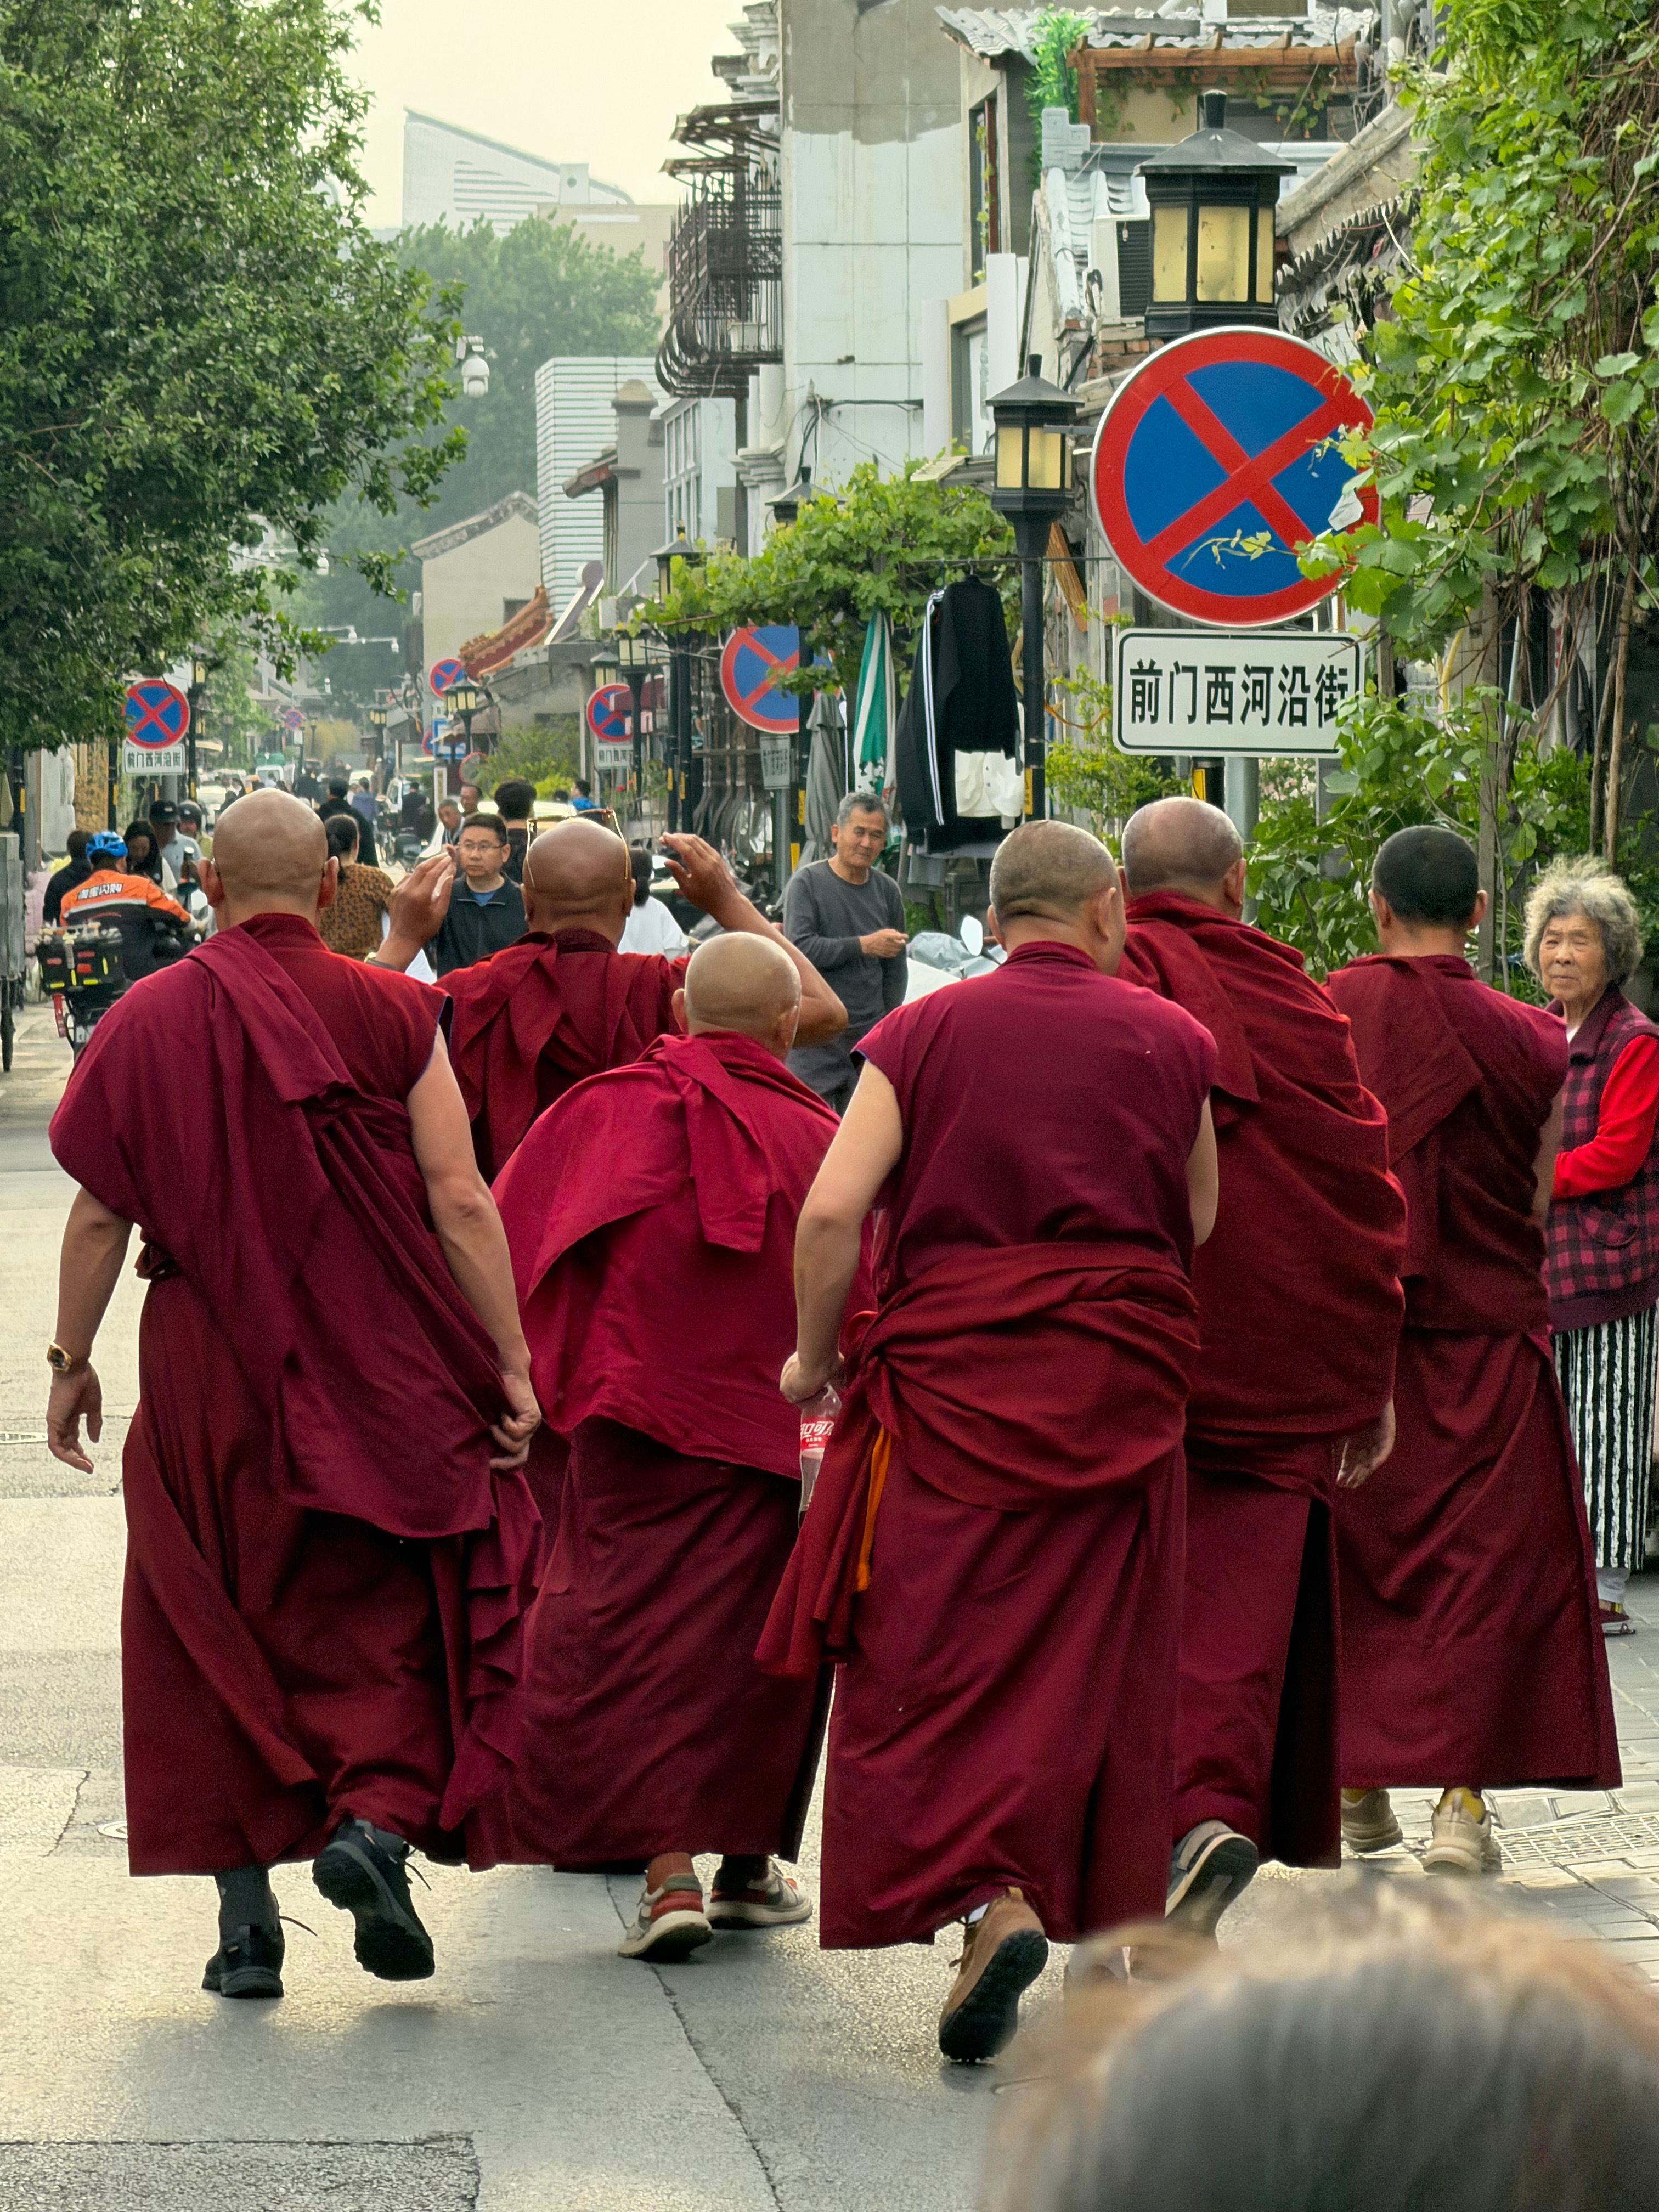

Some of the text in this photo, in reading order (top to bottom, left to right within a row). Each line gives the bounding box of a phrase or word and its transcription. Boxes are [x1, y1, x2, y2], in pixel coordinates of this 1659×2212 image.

[1129, 658, 1348, 728] 前门西河沿街
